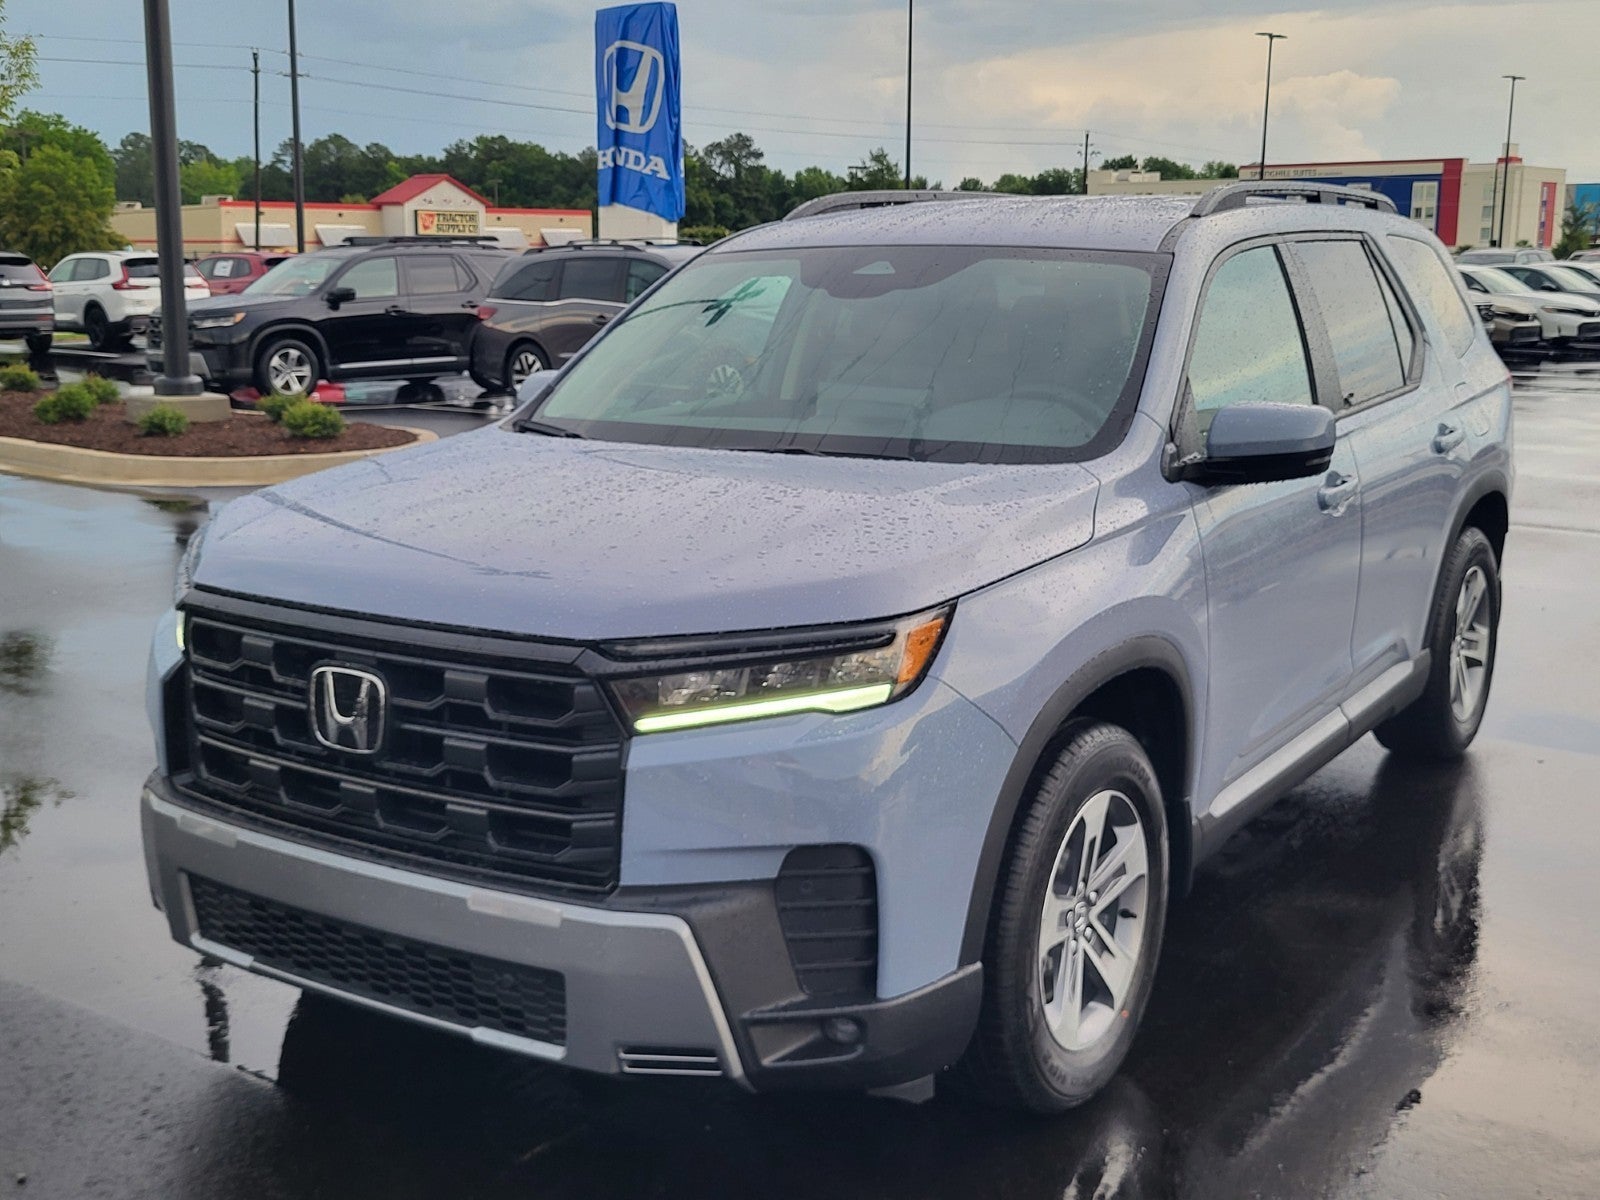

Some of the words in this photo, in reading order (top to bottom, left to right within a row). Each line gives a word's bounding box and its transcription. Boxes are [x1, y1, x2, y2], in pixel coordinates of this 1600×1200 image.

[597, 146, 671, 180] HNDA
[436, 213, 477, 223] TRACTOR
[436, 223, 466, 233] SUPPLY
